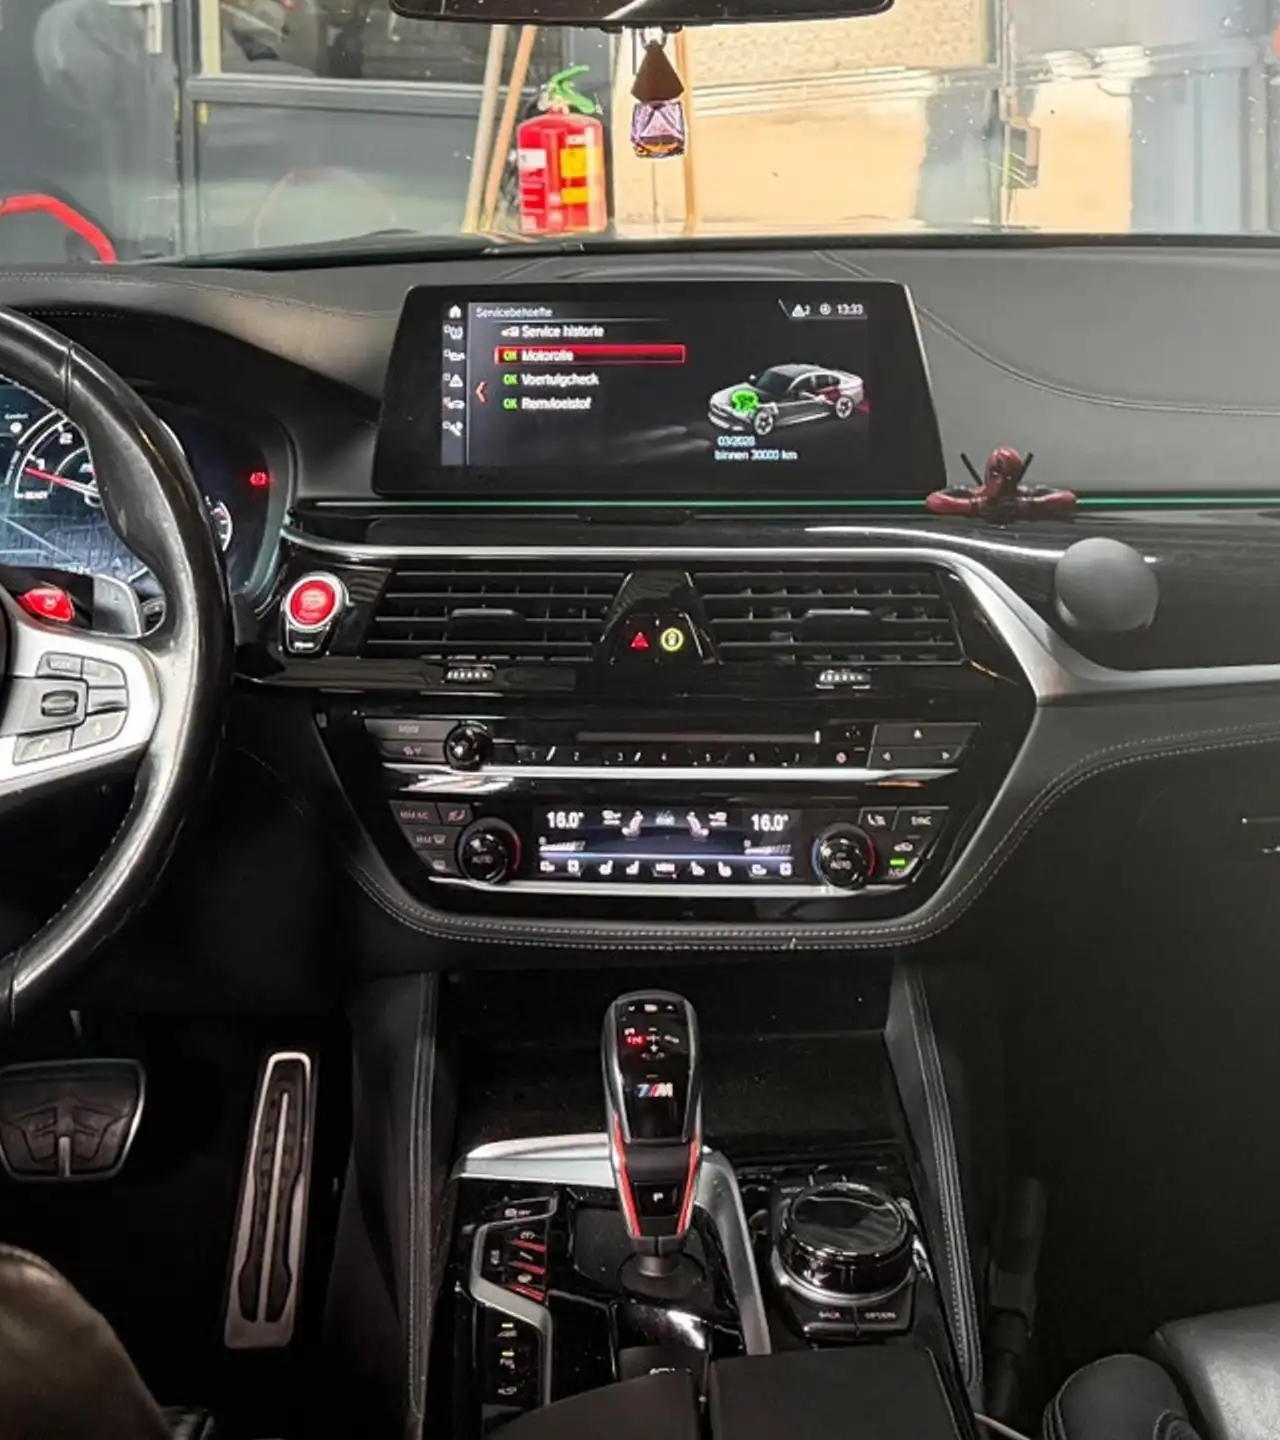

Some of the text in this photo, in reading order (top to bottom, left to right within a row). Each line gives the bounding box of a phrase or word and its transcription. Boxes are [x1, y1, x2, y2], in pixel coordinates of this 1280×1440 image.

[521, 325, 604, 338] Service historie
[502, 350, 518, 361] OK
[502, 374, 518, 386] OK
[502, 398, 518, 409] OK
[781, 449, 799, 461] km
